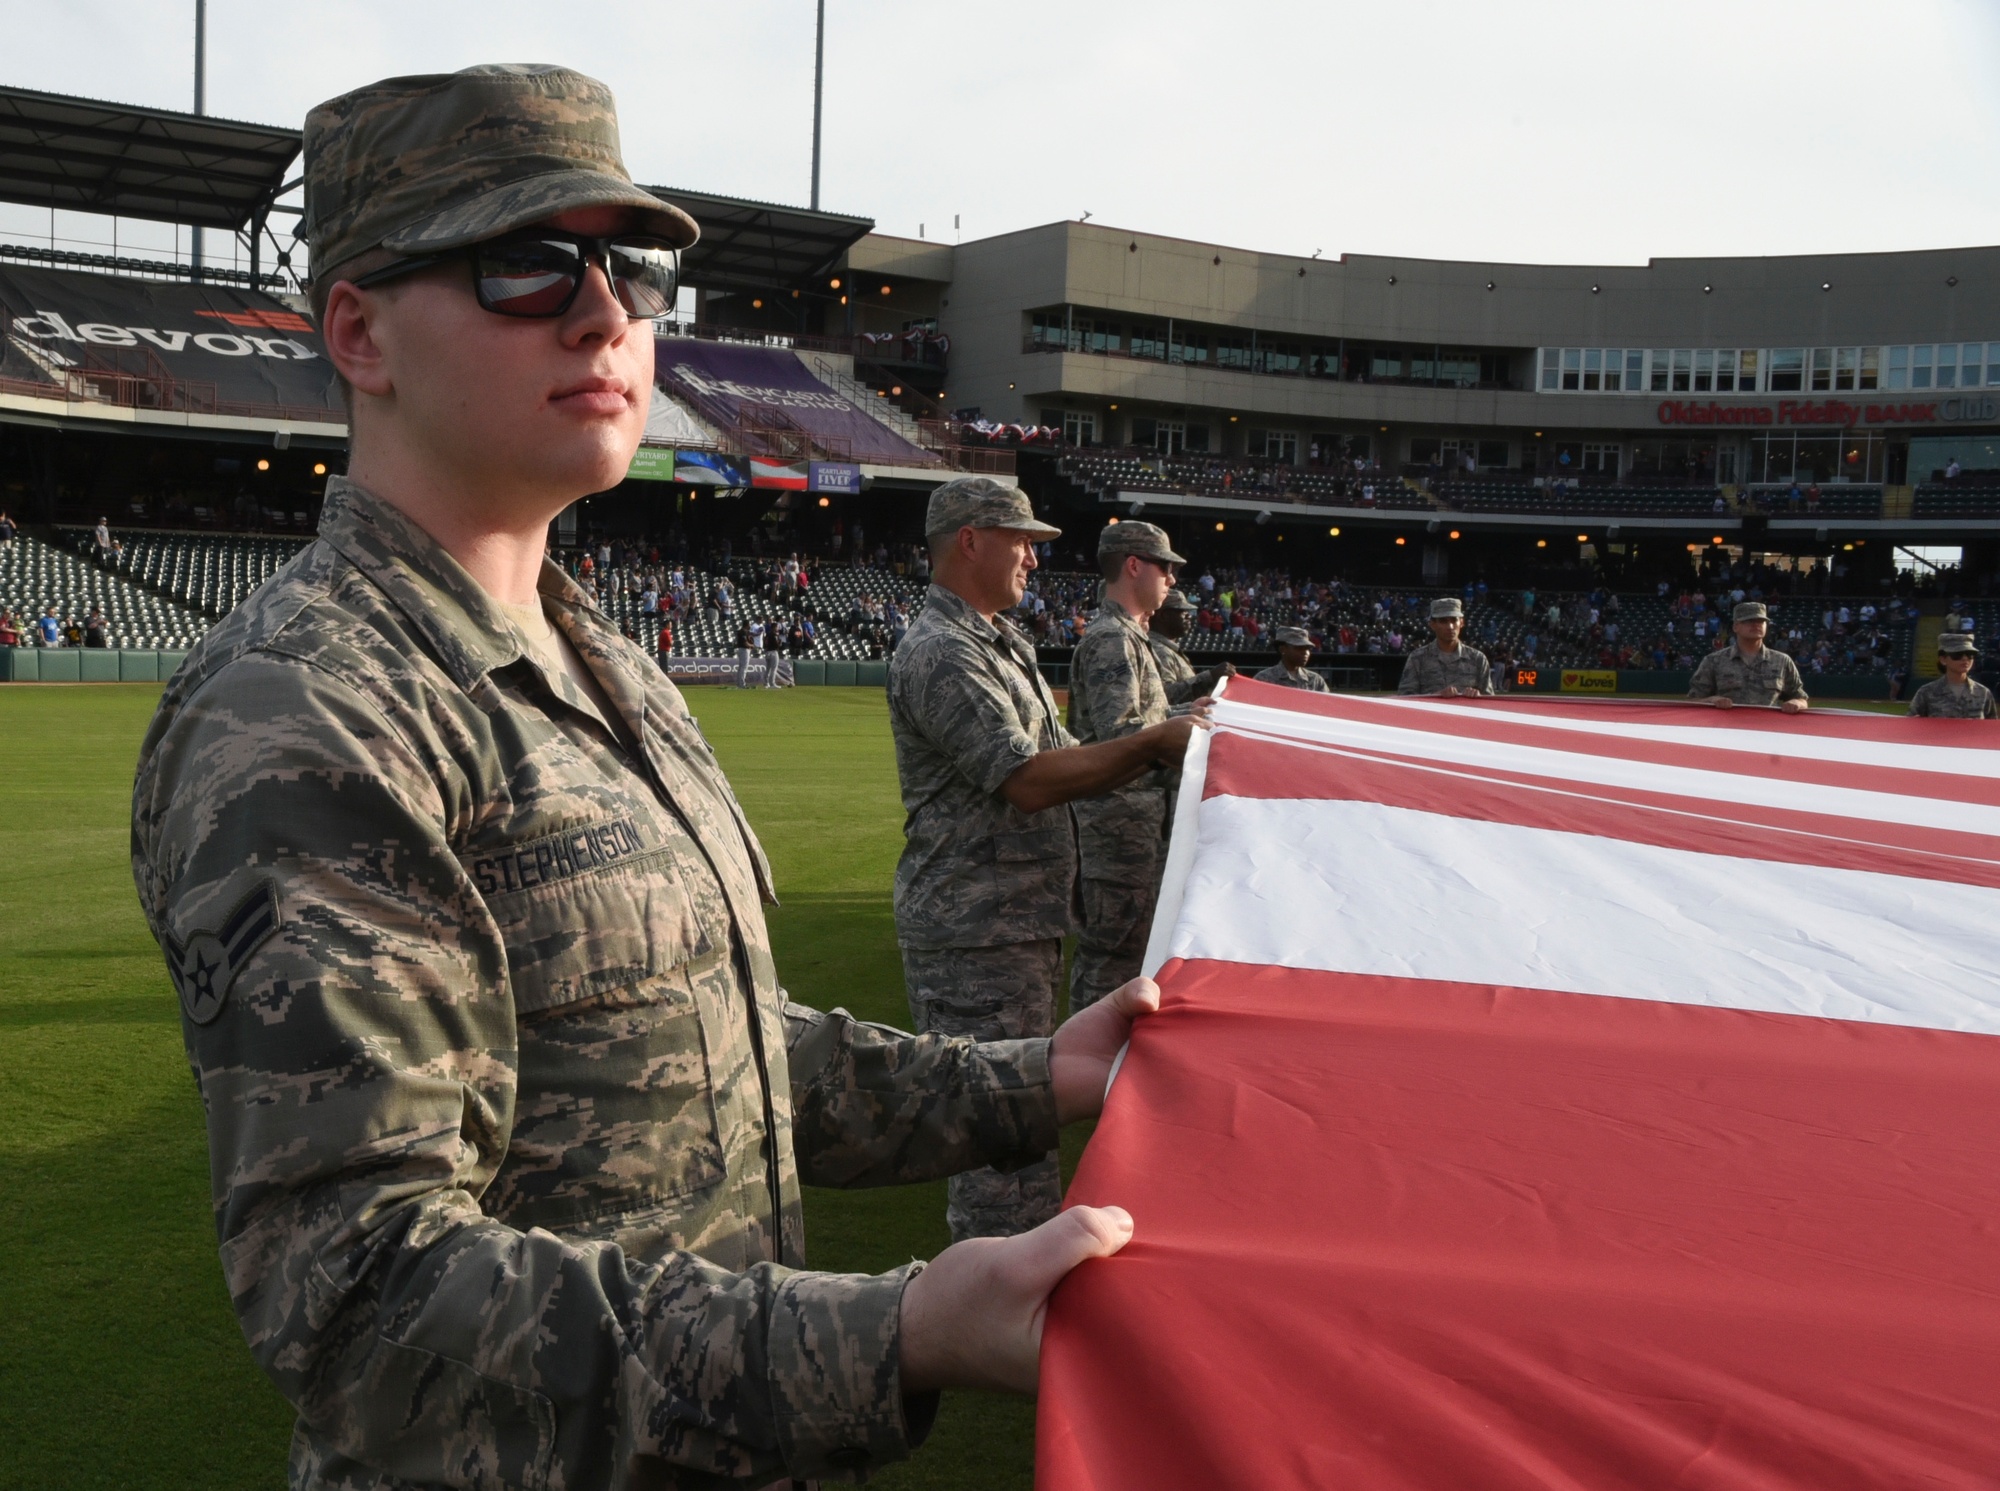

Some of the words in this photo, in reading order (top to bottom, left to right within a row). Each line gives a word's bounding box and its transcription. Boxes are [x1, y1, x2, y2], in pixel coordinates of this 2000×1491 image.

[12, 310, 319, 360] devon
[763, 396, 851, 412] CASINO
[1658, 399, 1773, 425] Oklahoma
[1778, 399, 1861, 429] Fidelity
[1865, 403, 1937, 423] BANK
[1940, 396, 1998, 422] Club
[818, 473, 851, 486] FLYER
[1579, 674, 1614, 688] Love's
[474, 817, 646, 895] STEPHENSON
